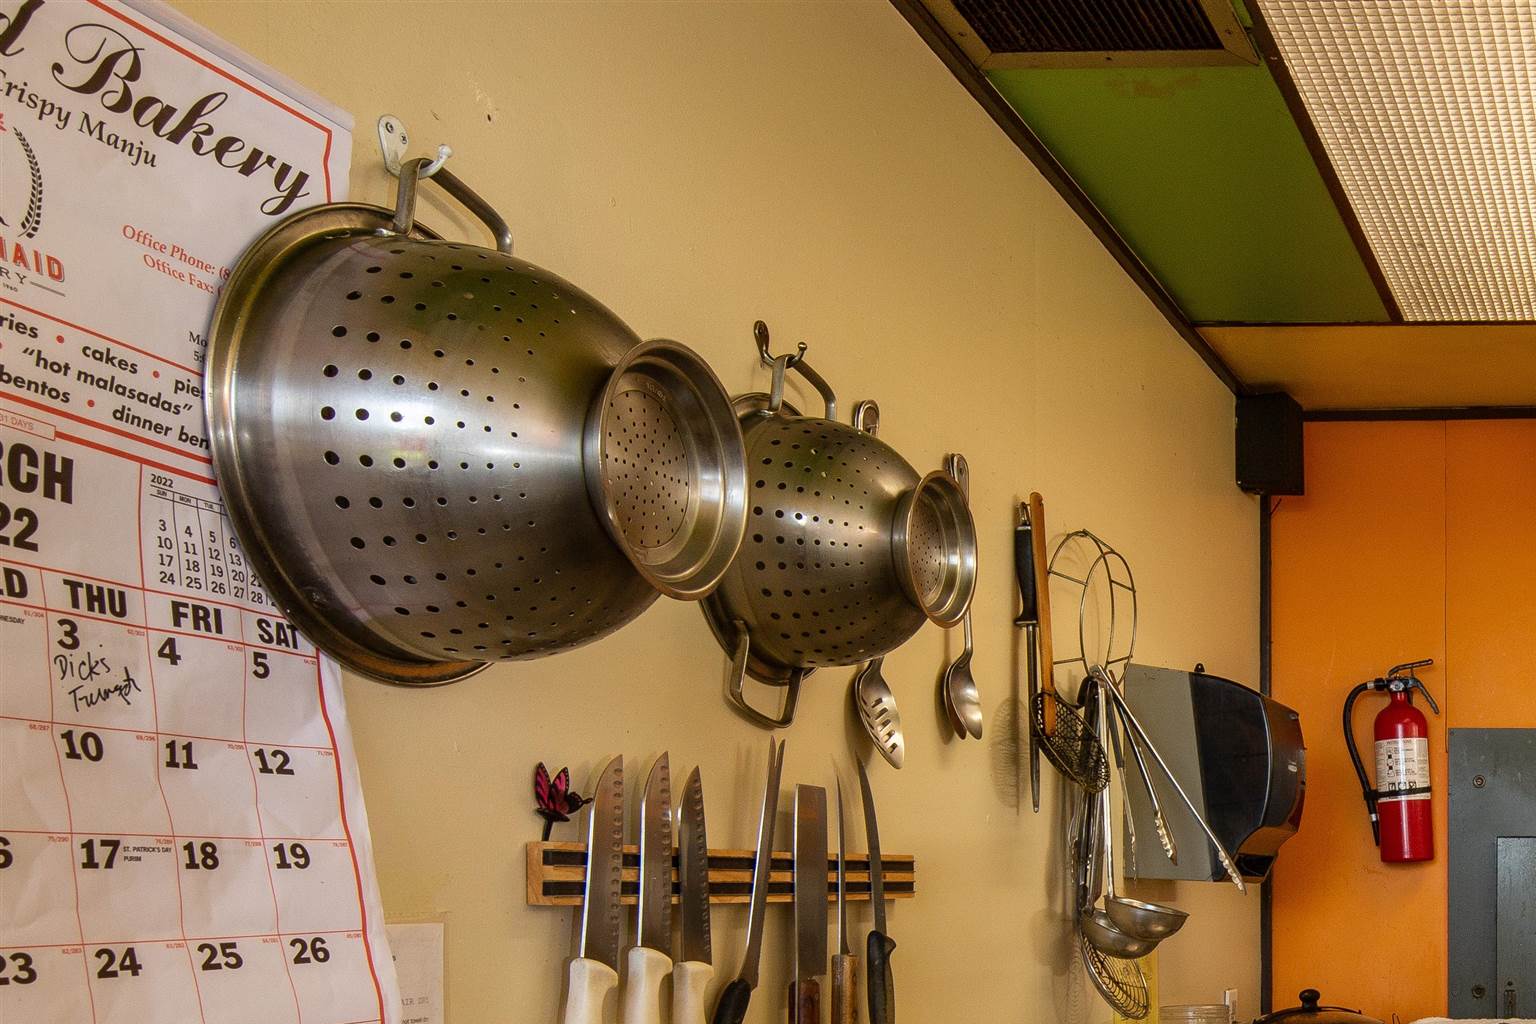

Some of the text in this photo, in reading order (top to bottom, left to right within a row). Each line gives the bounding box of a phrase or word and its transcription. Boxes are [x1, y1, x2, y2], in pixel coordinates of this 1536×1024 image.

[0, 68, 157, 168] rispy Manju
[51, 23, 310, 216] Bakery
[122, 224, 167, 254] Office
[170, 244, 215, 275] Phone:
[143, 254, 214, 295] Office Fax:
[81, 345, 138, 375] cakes
[11, 416, 34, 431] DAYS
[112, 404, 172, 438] dinner
[150, 473, 174, 489] 2022
[158, 519, 237, 550] 3 4 5 6
[157, 535, 242, 567] 10 11 12 13
[159, 553, 245, 583] 17 18 19 20
[159, 571, 264, 605] 24 25 26 27 28
[0, 566, 299, 651] D THU FRI SAT
[56, 618, 81, 651] 3
[157, 636, 182, 666] 4
[252, 651, 271, 680] 5
[60, 729, 104, 763] 10
[165, 739, 199, 770] 11
[253, 748, 296, 777] 12
[80, 838, 121, 870] 17
[183, 841, 220, 871] 18
[273, 842, 311, 870] 19
[94, 947, 143, 980] 24
[197, 942, 244, 971] 25
[289, 936, 331, 965] 26
